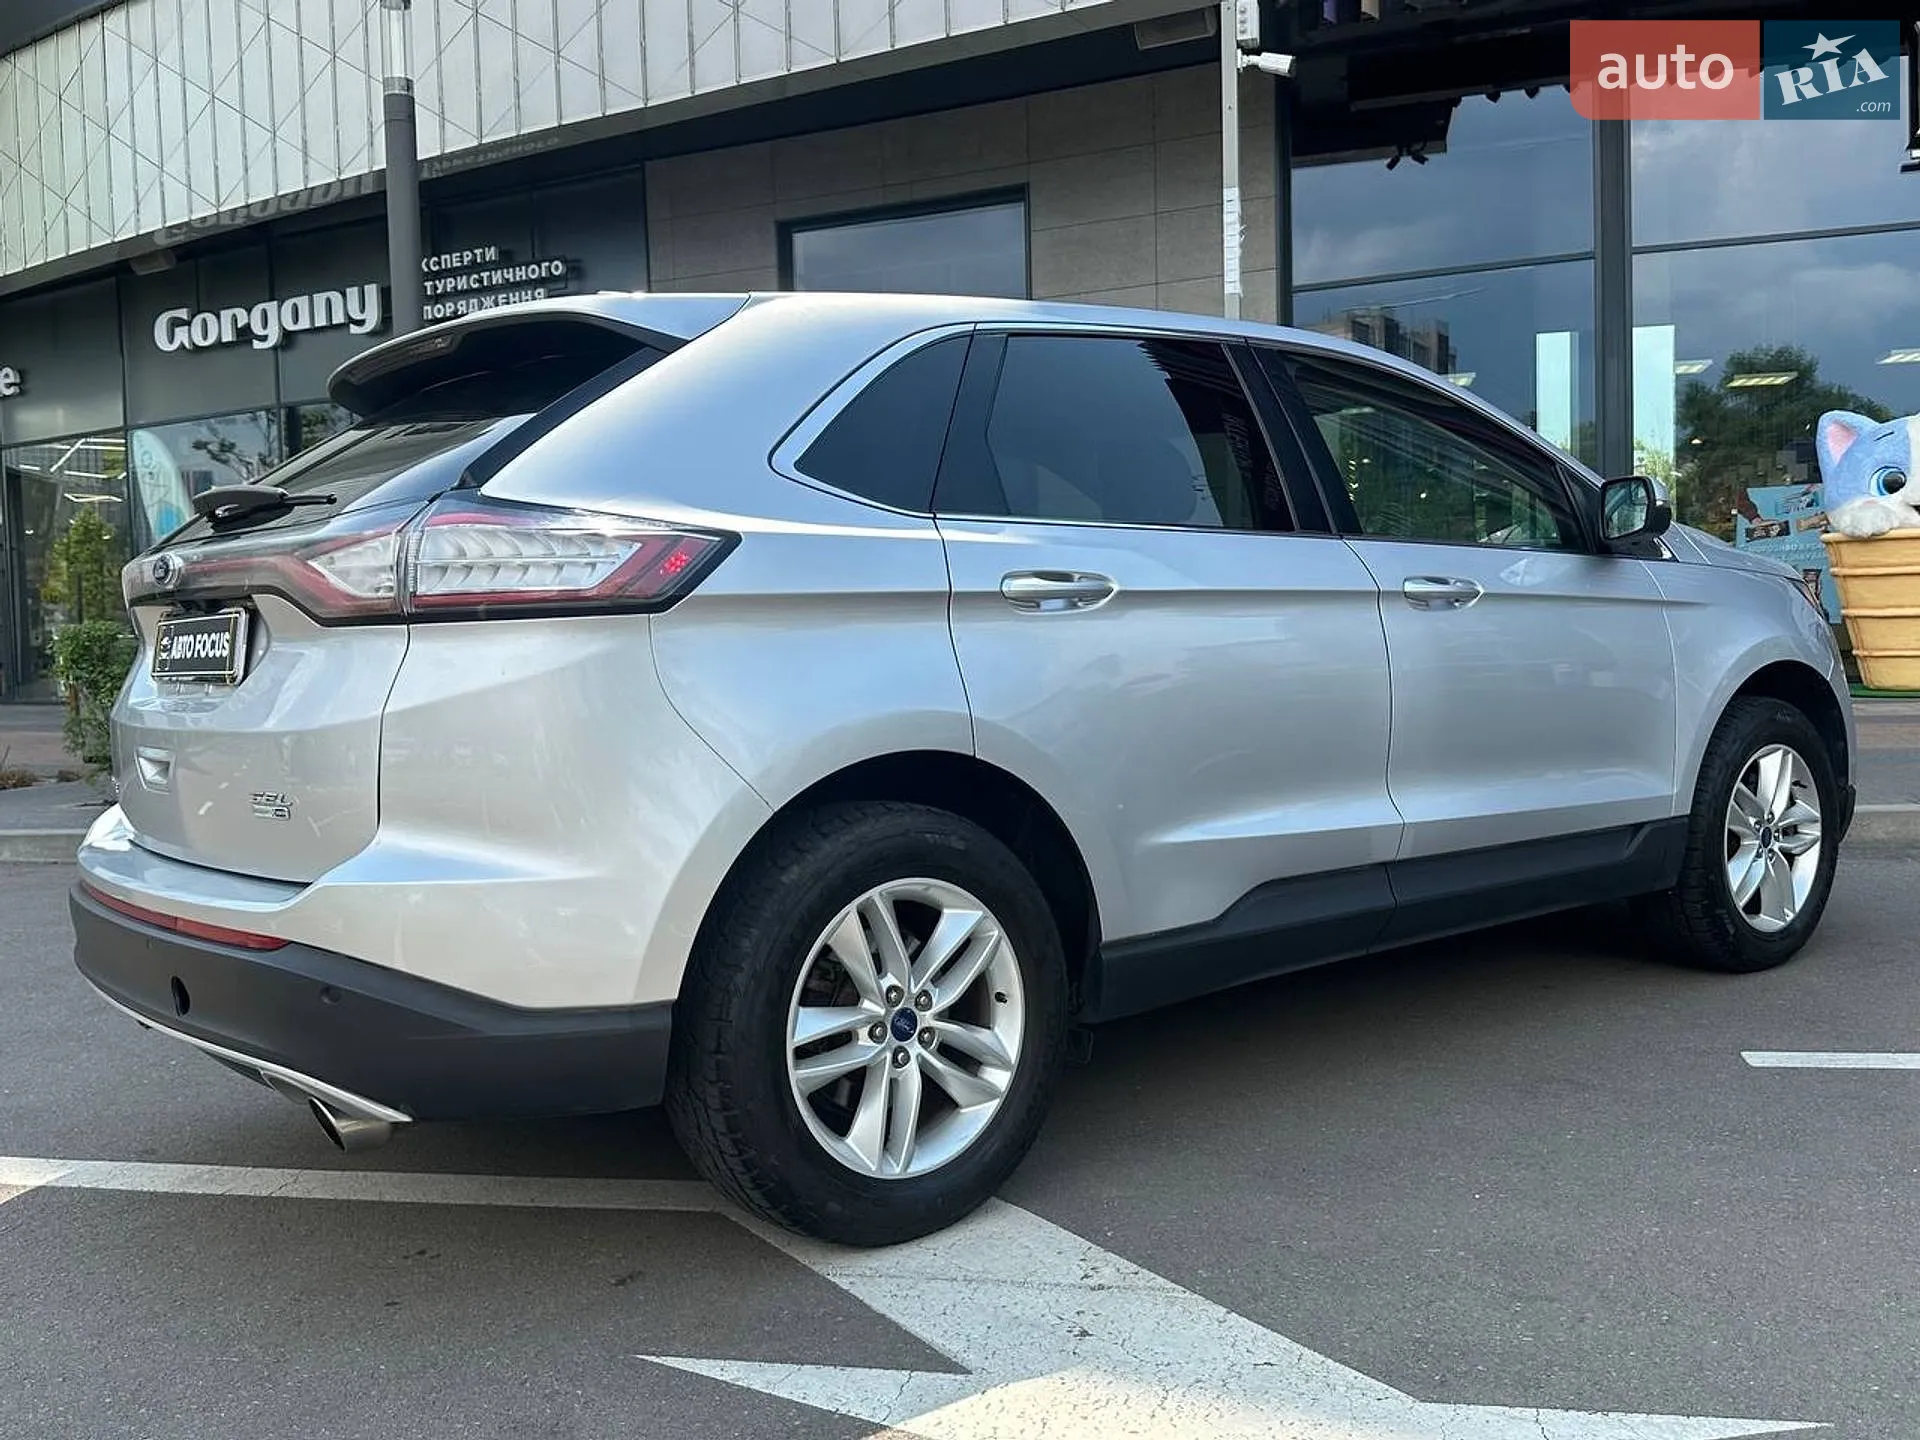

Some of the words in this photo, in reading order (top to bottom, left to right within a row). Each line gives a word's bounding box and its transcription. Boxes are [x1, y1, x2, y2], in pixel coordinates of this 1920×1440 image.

[424, 260, 564, 296] ТУРИСТИЧНОГО
[154, 284, 380, 352] Gorgany
[422, 288, 547, 320] ПОРЯДЖЕННЯ
[194, 631, 230, 658] FOCUS
